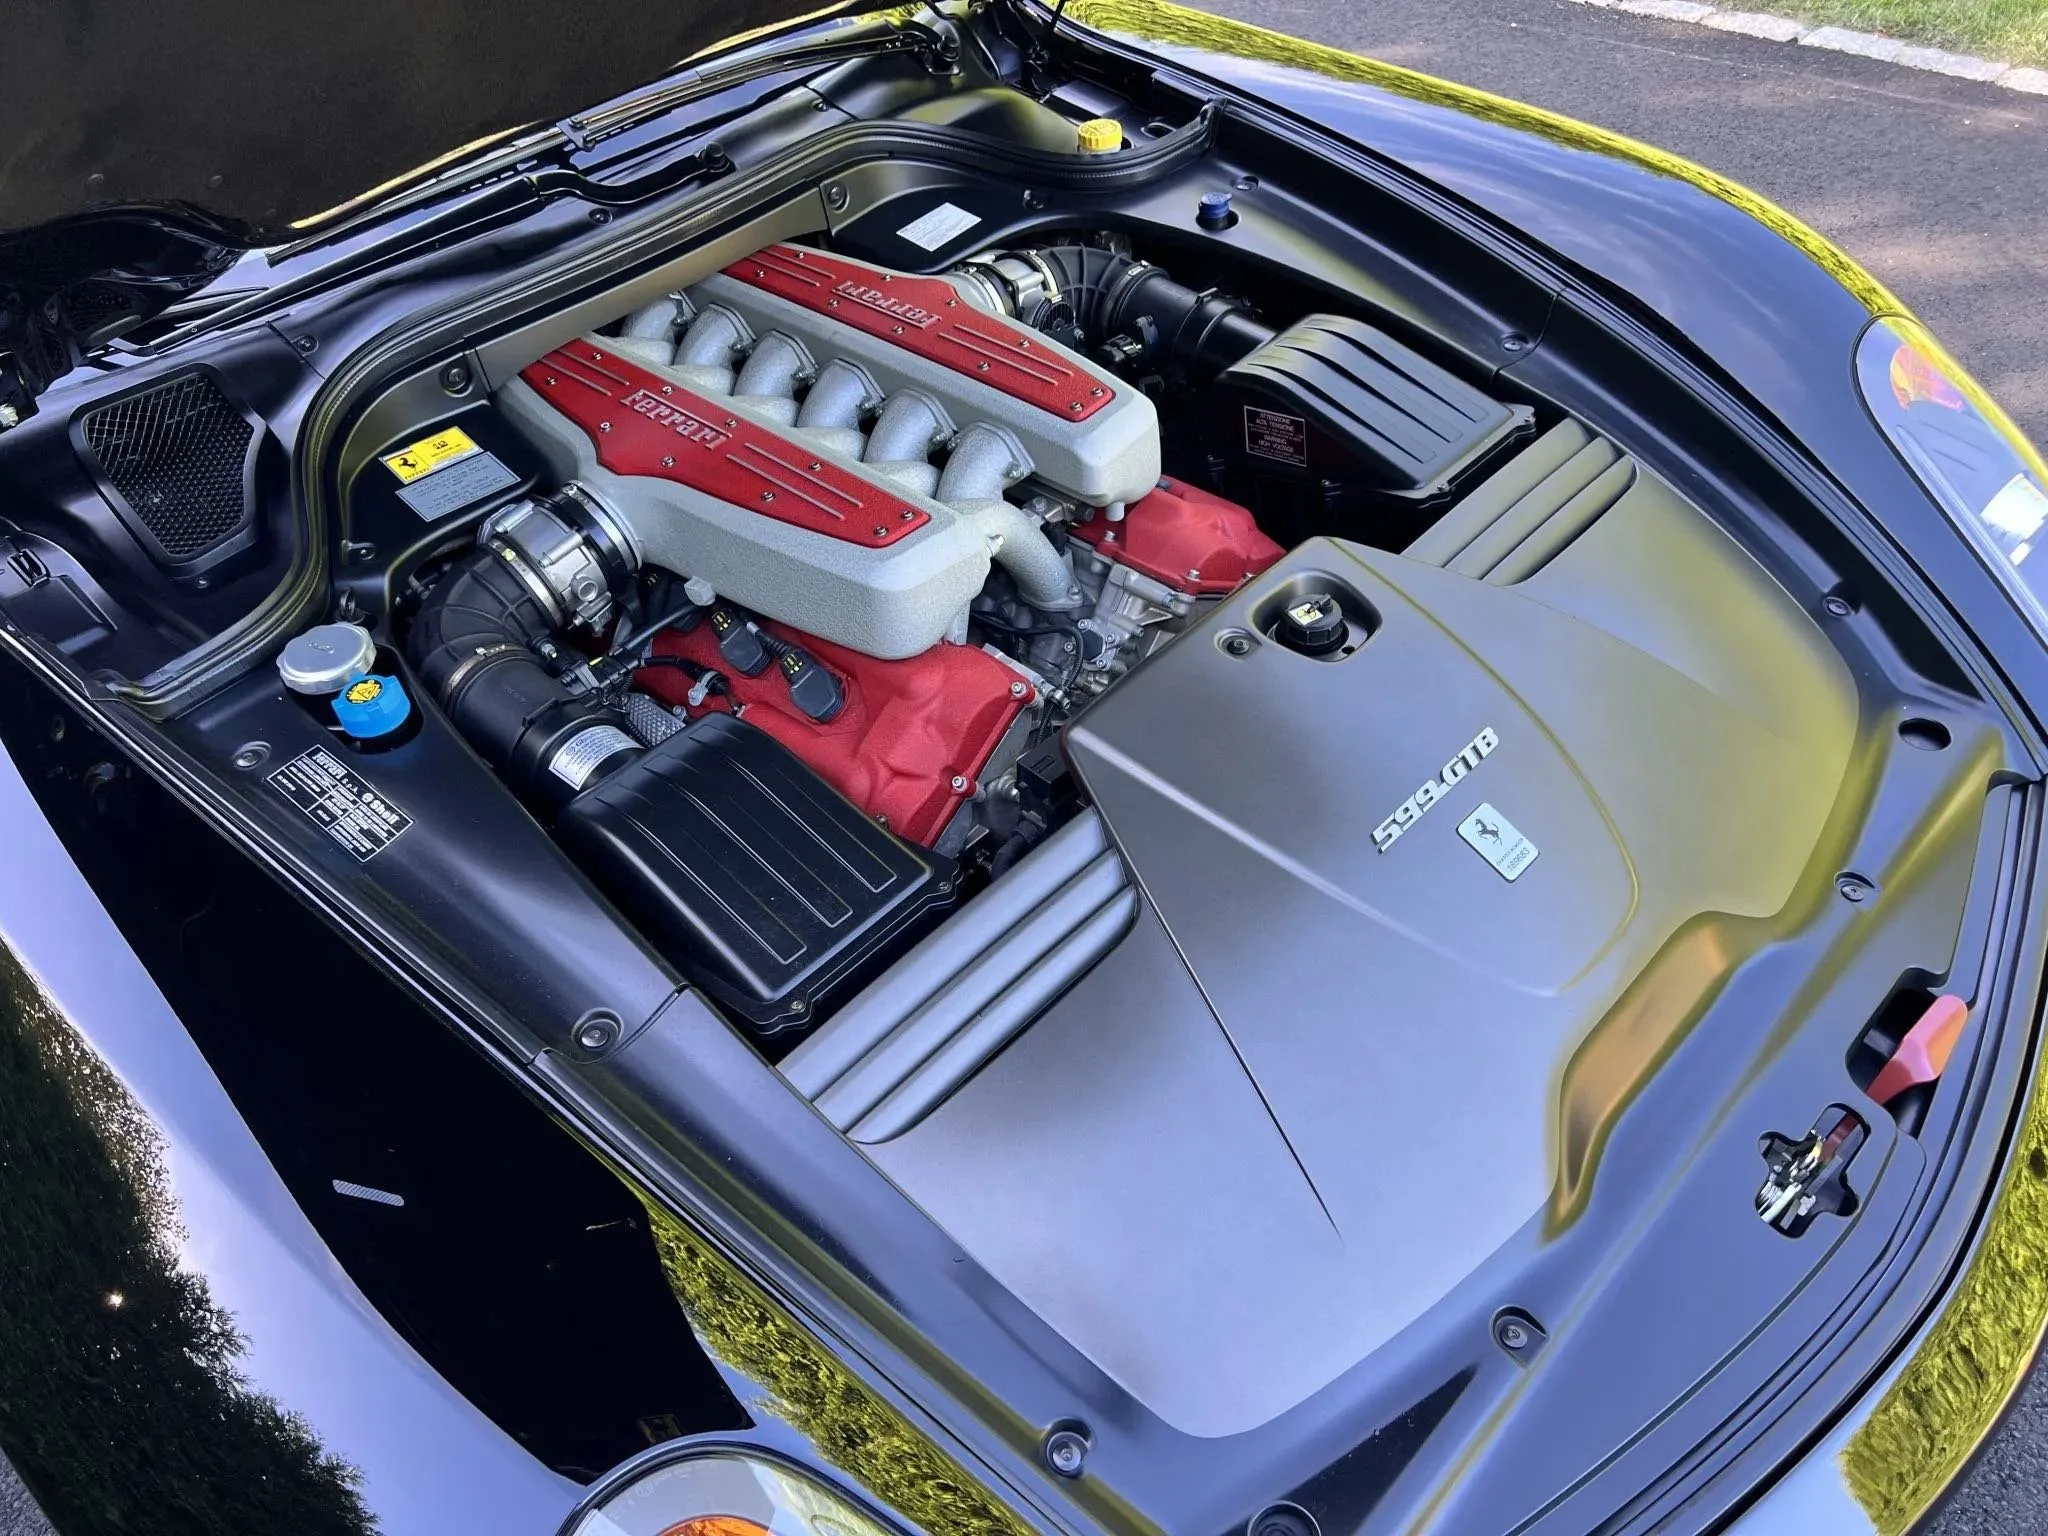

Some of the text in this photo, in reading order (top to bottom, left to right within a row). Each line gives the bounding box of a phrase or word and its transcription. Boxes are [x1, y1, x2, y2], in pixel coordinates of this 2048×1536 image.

[832, 280, 943, 330] Ferrari
[619, 389, 733, 451] Ferrari
[369, 799, 401, 825] Shell
[1370, 726, 1500, 856] 599 GTB
